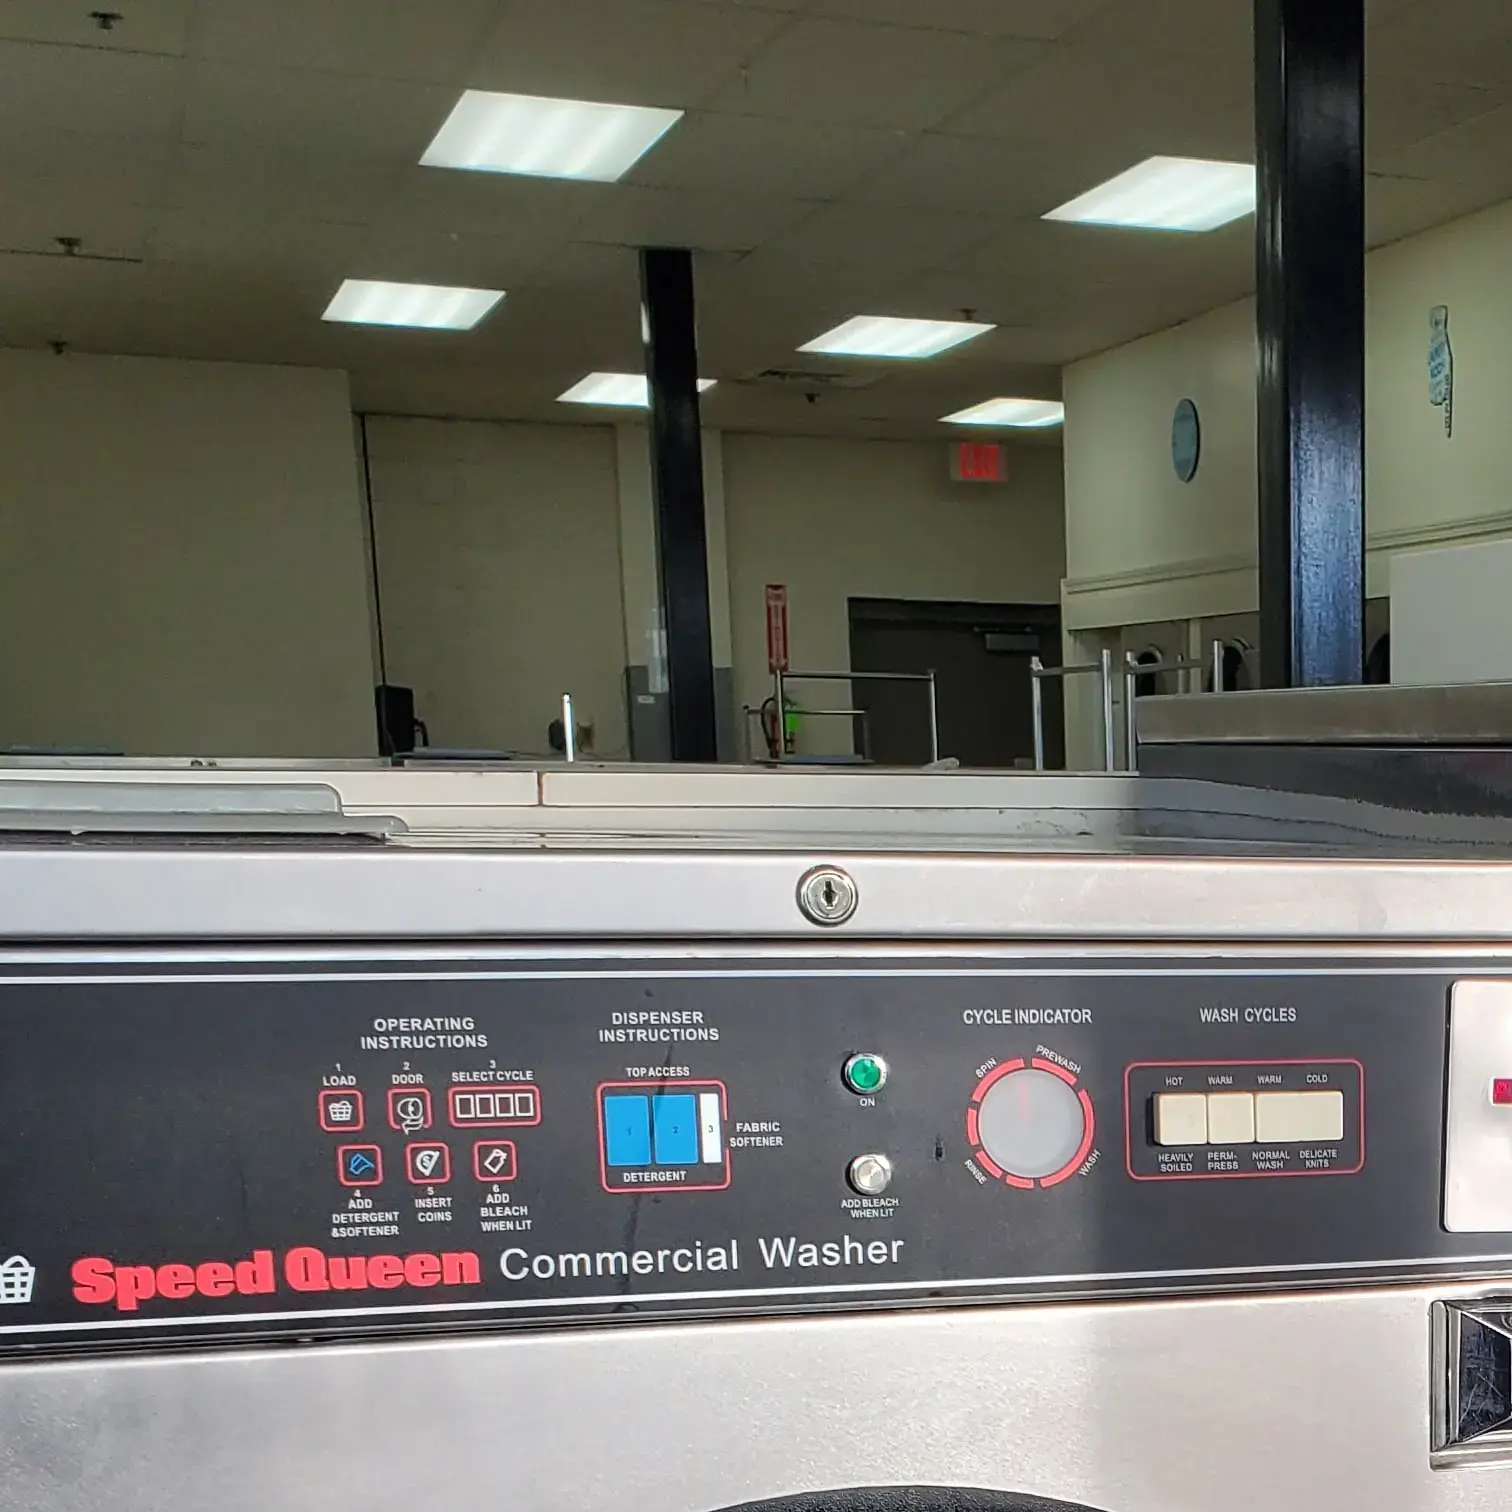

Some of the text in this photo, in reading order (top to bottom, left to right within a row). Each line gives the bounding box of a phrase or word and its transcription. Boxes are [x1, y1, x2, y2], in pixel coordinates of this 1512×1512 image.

[612, 1011, 704, 1025] DISPENSER
[963, 1009, 1092, 1024] CYCLE INDICATOR
[1200, 1007, 1297, 1022] WASH CYCLES
[374, 1017, 475, 1032] OPERATING
[600, 1028, 719, 1042] INSTRUCTIONS
[361, 1035, 488, 1050] INSTRUCTIONS
[490, 1060, 496, 1068] 3
[1036, 1044, 1081, 1074] PREWASH
[336, 1063, 341, 1071] 1
[403, 1062, 410, 1070] 2
[975, 1057, 997, 1078] SPIN
[452, 1071, 534, 1082] SELECT CYCLE
[626, 1067, 690, 1077] TOP ACCESS
[323, 1075, 356, 1086] LOAD
[392, 1074, 424, 1084] DOOR
[1166, 1077, 1183, 1086] HOT
[1208, 1076, 1233, 1085] WARM
[1258, 1075, 1282, 1084] WARM
[1306, 1074, 1327, 1083] COLD
[708, 1125, 713, 1133] 3
[736, 1123, 780, 1132] FABRIC
[730, 1137, 783, 1147] SOFTENER
[1158, 1153, 1193, 1162] HEAVILY
[1208, 1152, 1237, 1161] PERM-
[1252, 1151, 1290, 1160] NORMAL
[1300, 1149, 1337, 1159] DELICATE
[1078, 1149, 1101, 1176] WASH
[1161, 1163, 1192, 1172] SOILED
[1208, 1161, 1238, 1170] PRESS
[1257, 1160, 1283, 1169] WASH
[1306, 1159, 1329, 1168] KNITS
[623, 1171, 686, 1182] DETERGENT
[964, 1159, 987, 1185] RINSE
[354, 1189, 361, 1198] 4
[427, 1187, 434, 1195] 5
[493, 1184, 499, 1193] 6
[415, 1198, 452, 1208] INSERT
[486, 1193, 509, 1204] ADD
[842, 1198, 899, 1208] ADD BLEACH
[349, 1199, 372, 1209] ADD
[481, 1206, 528, 1217] BLEACH
[851, 1209, 894, 1218] WHEN LIT
[332, 1212, 399, 1224] DETERGENT
[418, 1212, 452, 1222] COINS
[481, 1220, 532, 1232] WHEN LIT
[332, 1226, 399, 1238] &SOFTENER
[72, 1235, 905, 1311] Speed Queen Commercial Washer
